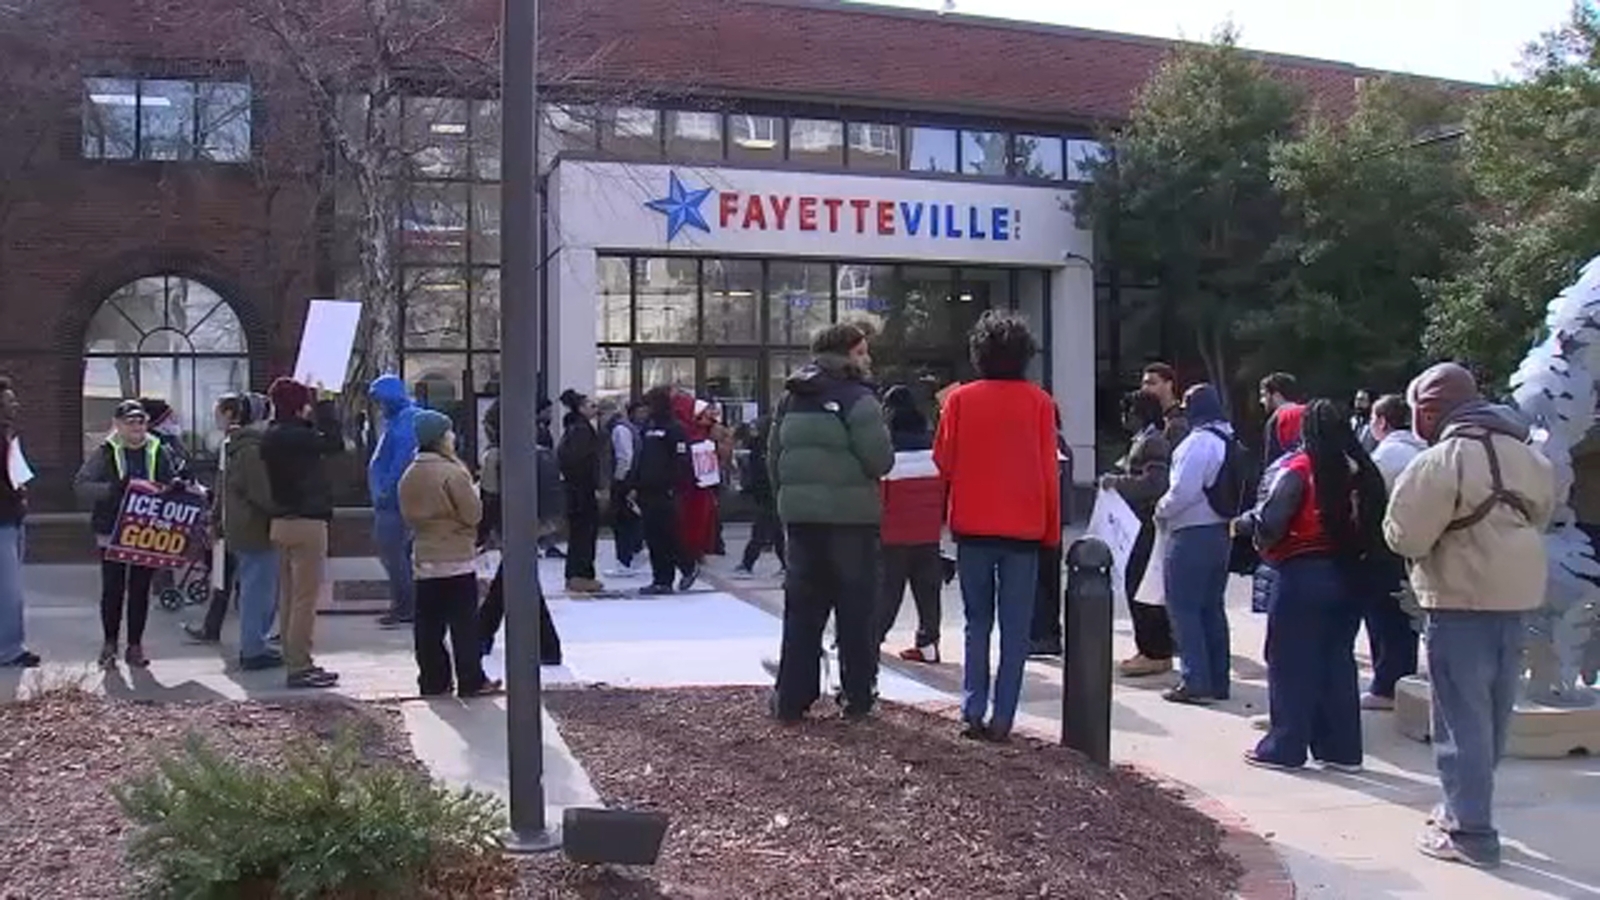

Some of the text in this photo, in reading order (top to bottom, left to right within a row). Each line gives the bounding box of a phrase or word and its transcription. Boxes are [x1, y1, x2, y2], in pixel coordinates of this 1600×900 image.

[719, 192, 1009, 241] FAYETTEVILLE
[126, 494, 200, 525] ICE OUT
[120, 525, 186, 554] GOOD
